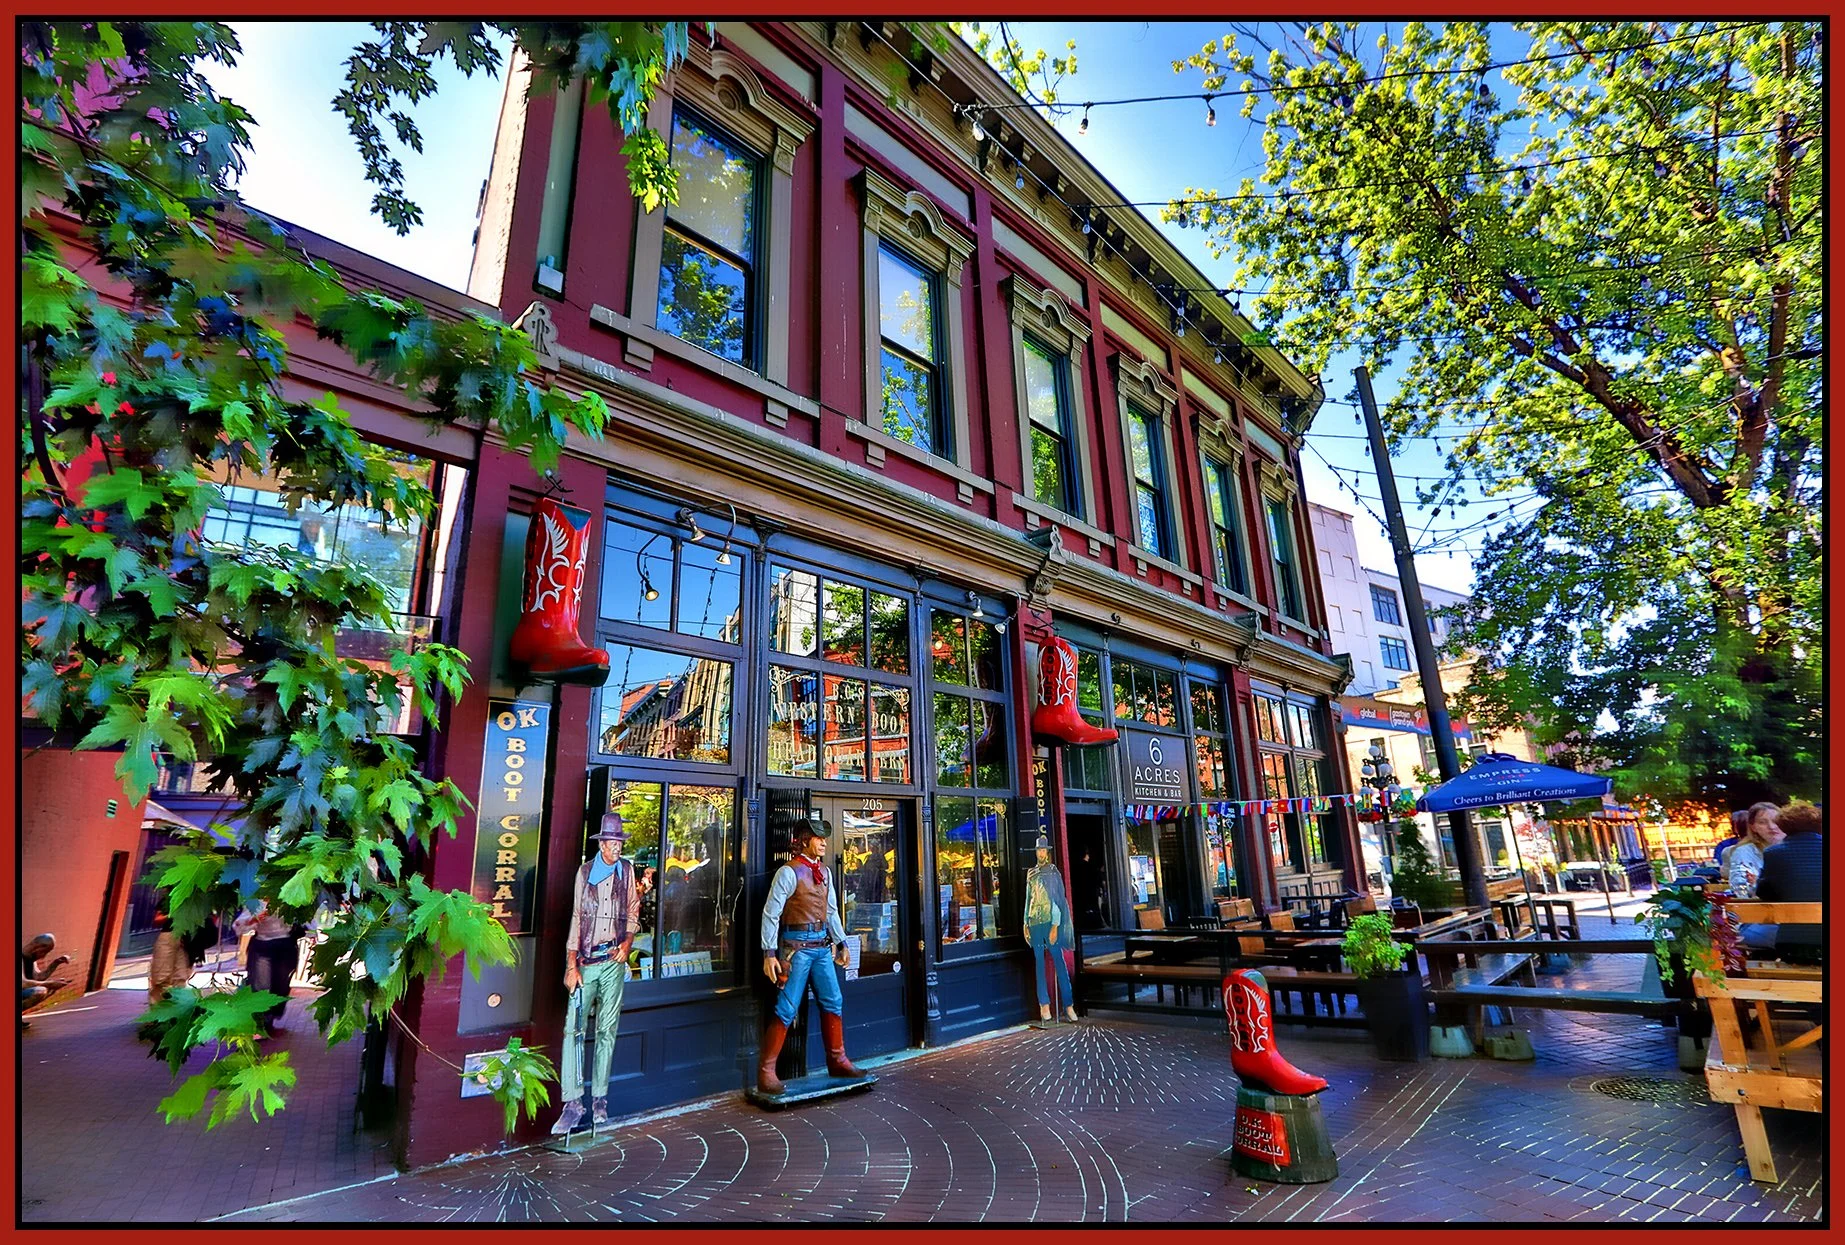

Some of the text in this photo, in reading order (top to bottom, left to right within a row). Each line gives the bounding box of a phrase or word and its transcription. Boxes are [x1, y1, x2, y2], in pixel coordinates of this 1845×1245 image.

[773, 701, 906, 735] WESTERN BOOT
[1360, 708, 1377, 719] global
[1149, 737, 1163, 766] 6
[1032, 761, 1047, 776] OK
[1134, 766, 1181, 784] ACRES
[1469, 767, 1541, 780] EMPRESS
[1036, 779, 1046, 818] BOOT
[1134, 787, 1182, 798] KITCHEN & BAR
[1454, 796, 1483, 805] Cheers
[1496, 790, 1531, 801] Brilliant
[1533, 787, 1577, 797] Creations
[491, 708, 540, 918] OK BOOT CORRAL
[862, 798, 883, 811] 205
